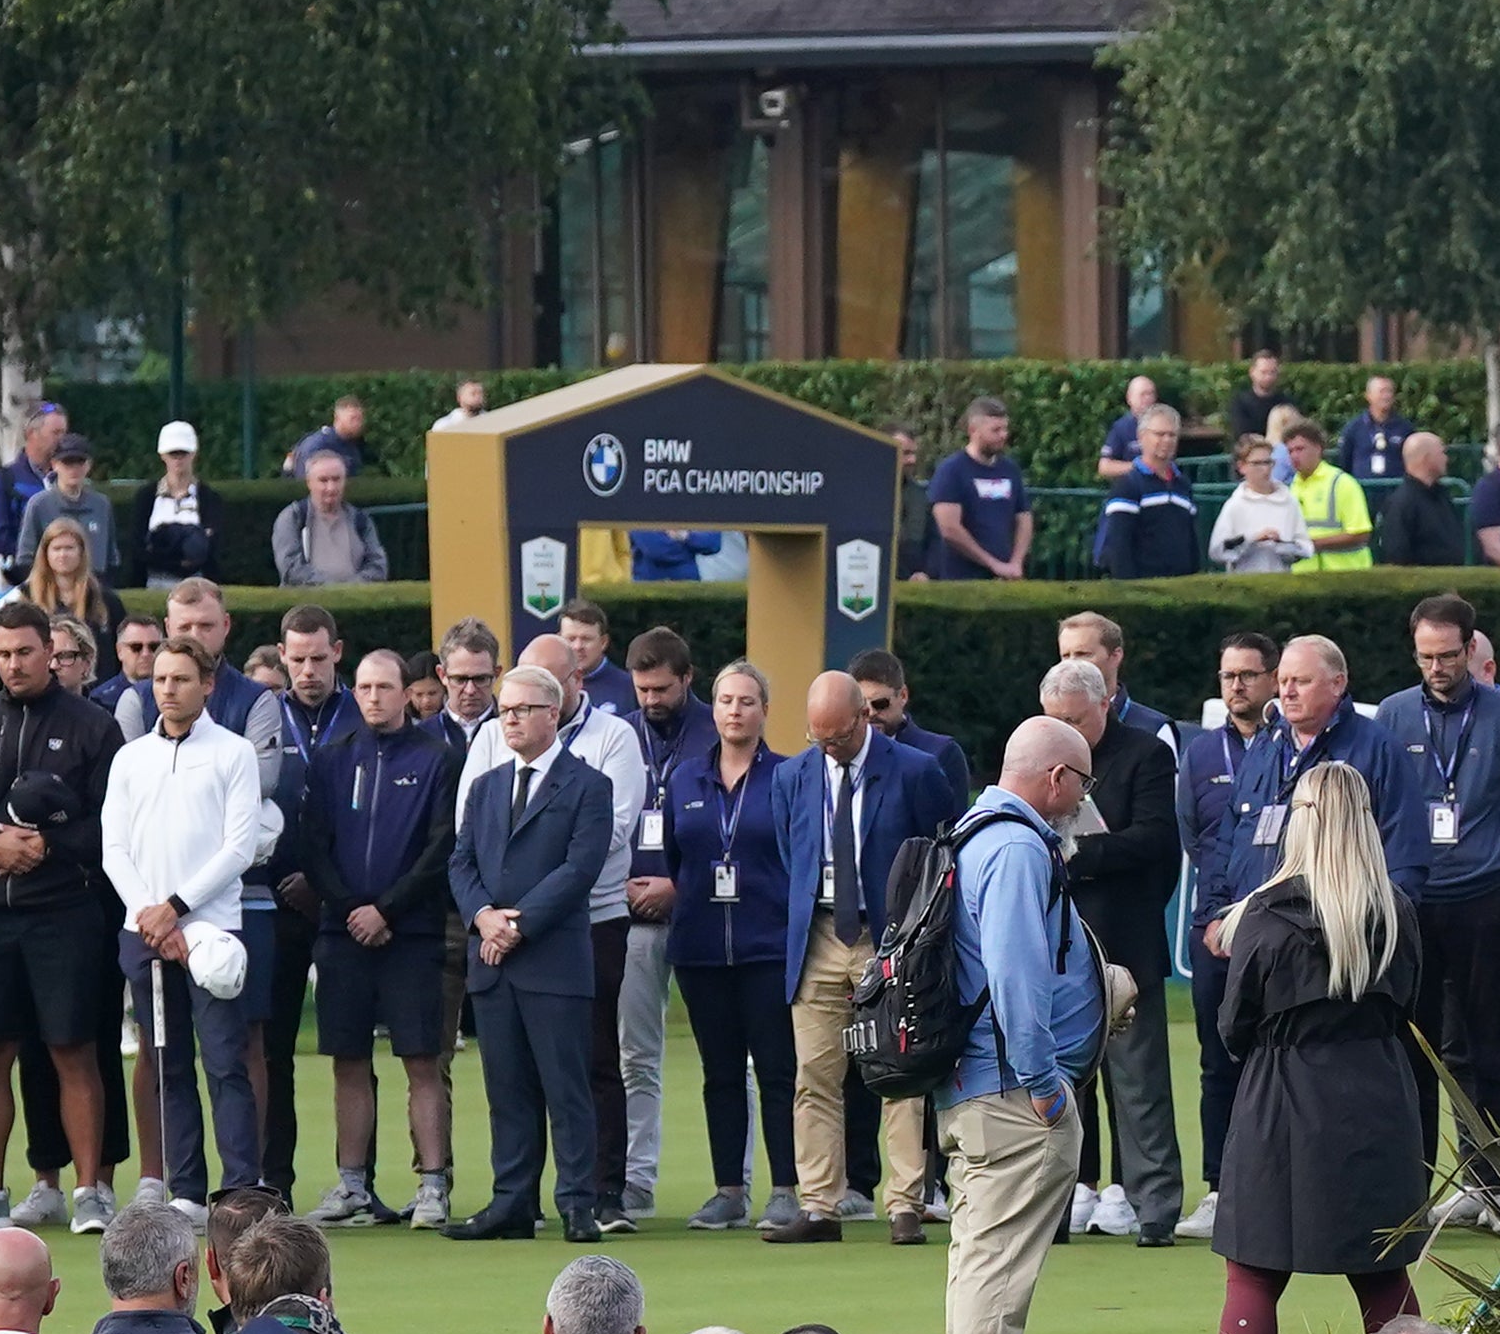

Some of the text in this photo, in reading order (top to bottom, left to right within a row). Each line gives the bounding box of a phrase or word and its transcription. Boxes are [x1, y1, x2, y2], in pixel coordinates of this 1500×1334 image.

[644, 438, 691, 463] BMW
[643, 469, 824, 495] PGA CHAMPIONSHIP
